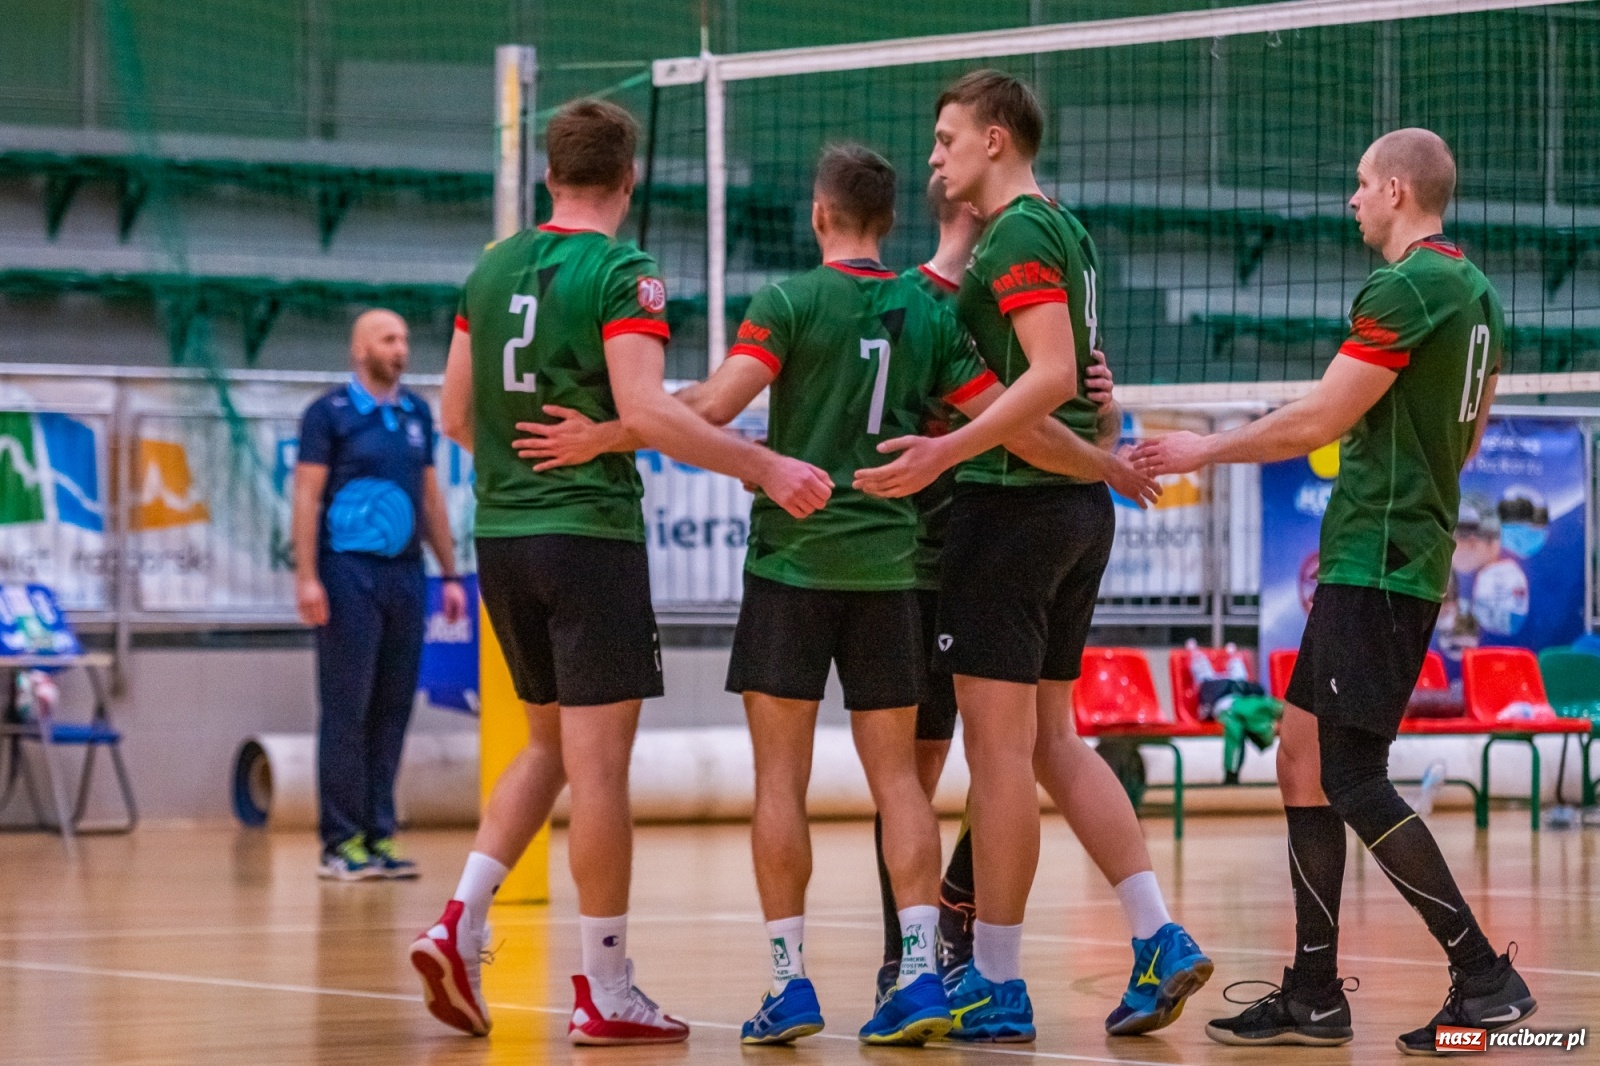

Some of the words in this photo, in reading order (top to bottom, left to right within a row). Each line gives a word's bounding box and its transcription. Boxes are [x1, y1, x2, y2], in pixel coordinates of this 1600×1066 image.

[503, 294, 537, 392] 2
[860, 338, 890, 434] 7
[1458, 324, 1490, 422] 13
[645, 508, 747, 549] iera
